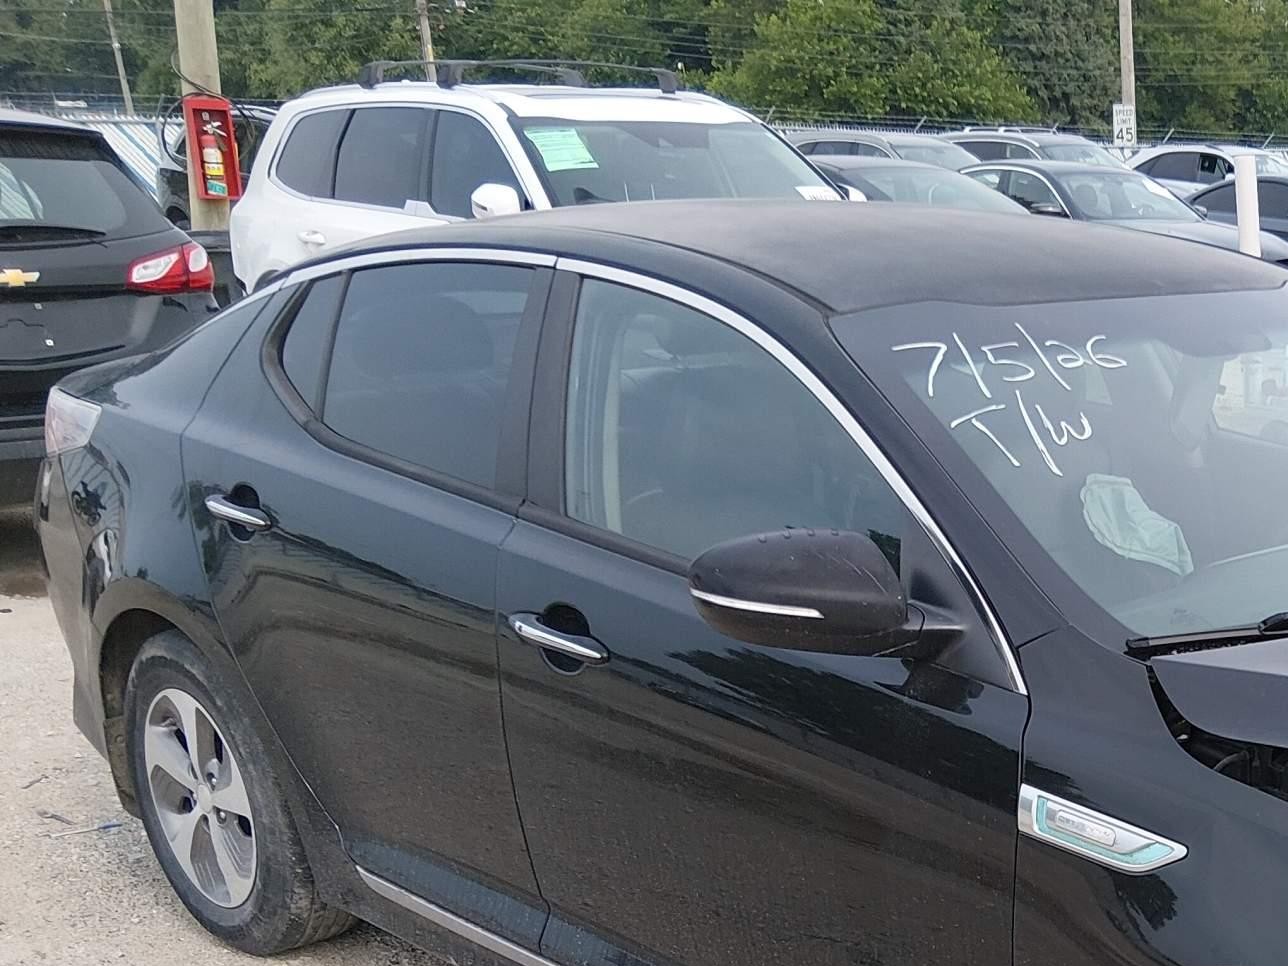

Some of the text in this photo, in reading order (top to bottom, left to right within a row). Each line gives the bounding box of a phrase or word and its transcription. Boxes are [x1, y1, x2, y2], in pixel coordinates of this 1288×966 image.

[1115, 108, 1134, 117] SPEED
[1116, 118, 1131, 126] LIMIT
[1115, 127, 1134, 143] 45
[891, 322, 1128, 398] 7/5/26
